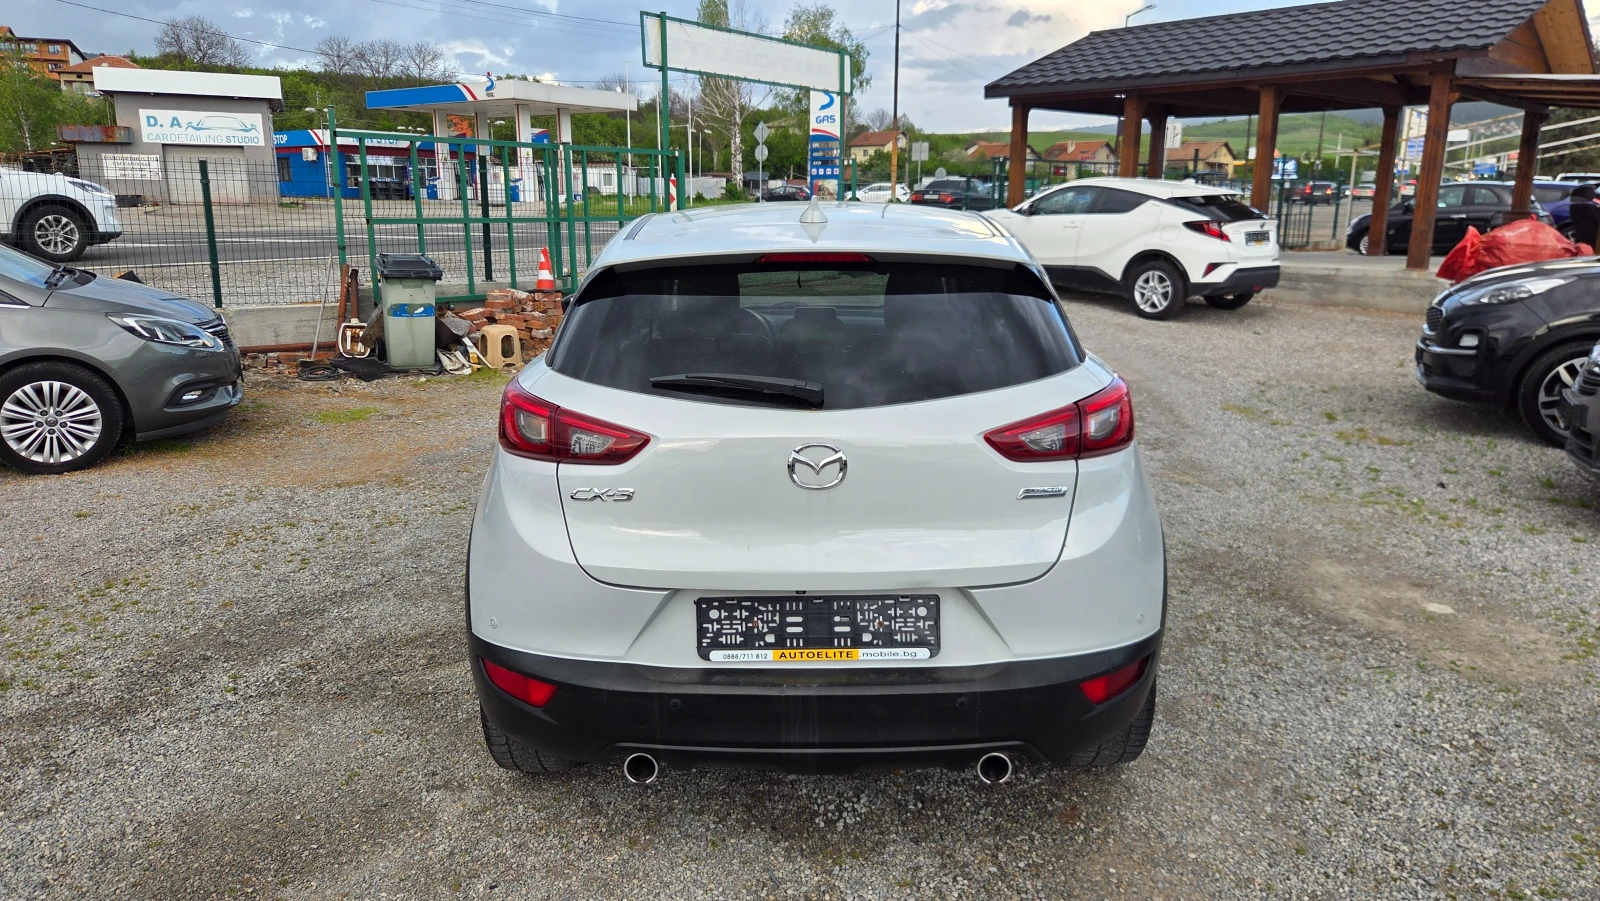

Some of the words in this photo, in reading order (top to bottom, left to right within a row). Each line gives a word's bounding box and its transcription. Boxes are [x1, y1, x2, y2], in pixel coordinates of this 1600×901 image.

[146, 115, 164, 128] D.
[170, 116, 183, 128] A
[815, 115, 836, 124] GAS
[225, 135, 260, 145] STUDIO
[273, 134, 288, 144] STOP
[570, 487, 635, 502] CX-3
[778, 650, 854, 659] AUTOELITE
